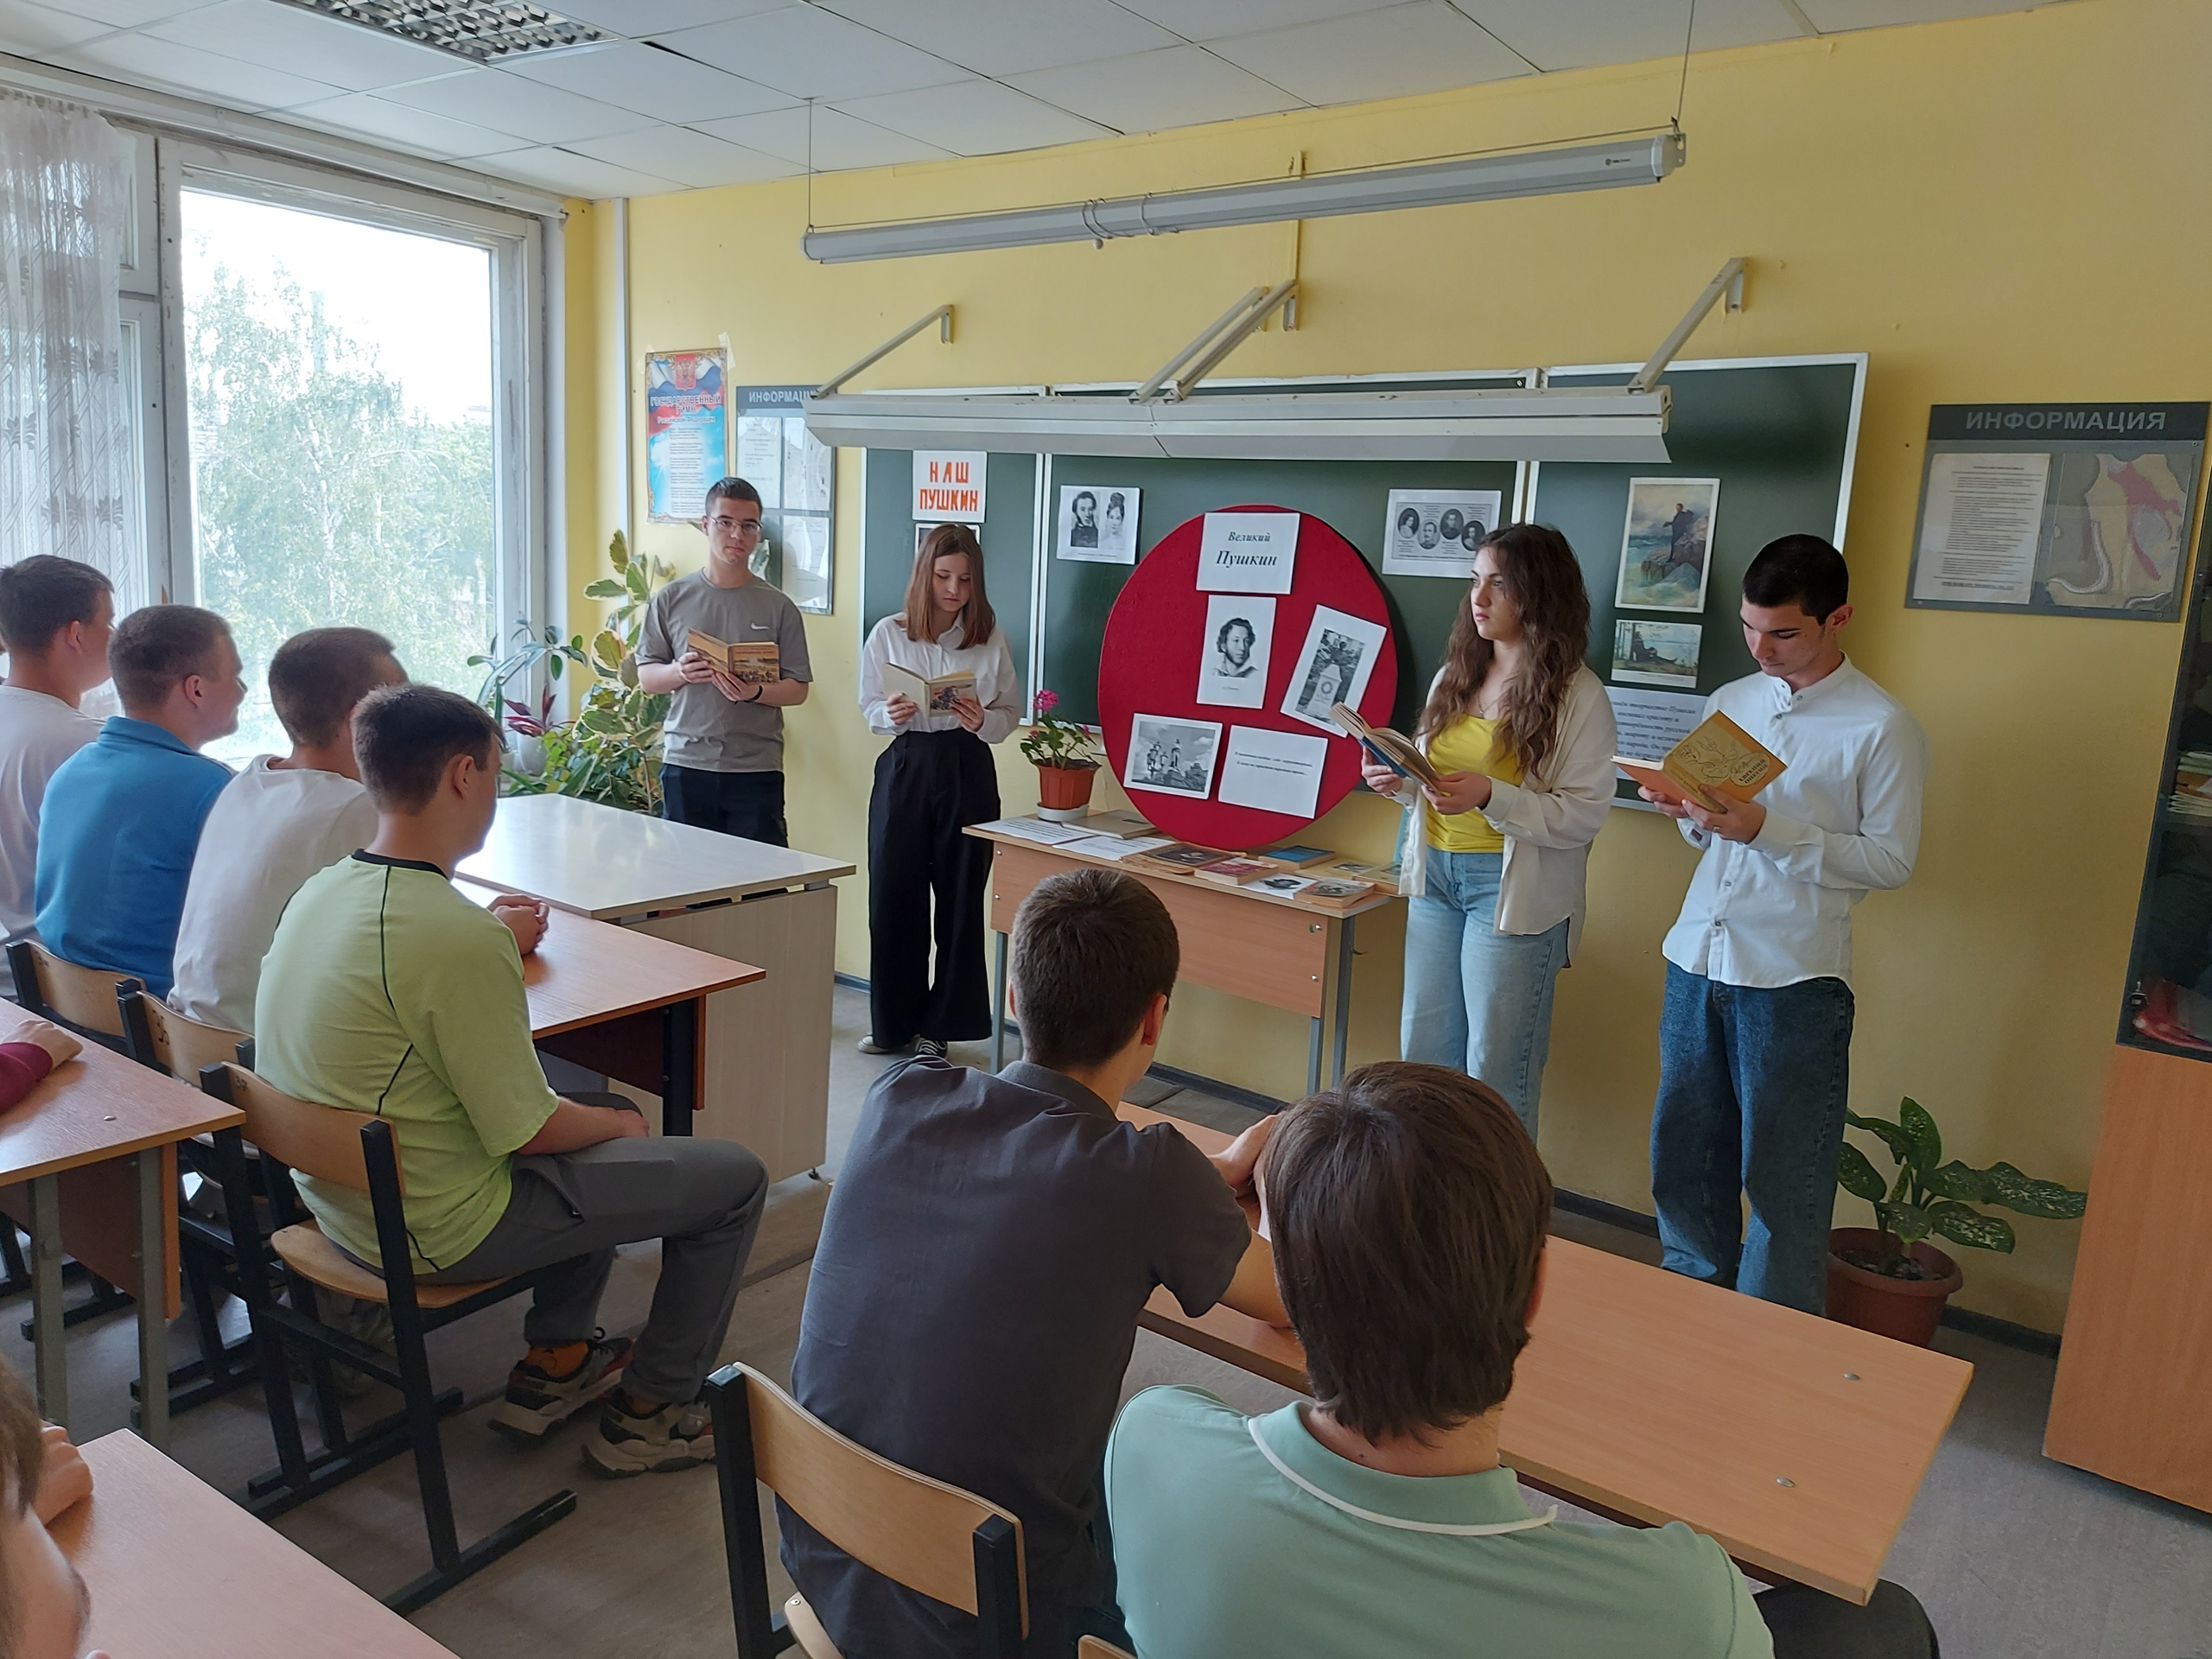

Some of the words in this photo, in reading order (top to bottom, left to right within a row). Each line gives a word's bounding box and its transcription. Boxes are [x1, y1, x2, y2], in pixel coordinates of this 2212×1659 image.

[650, 393, 721, 406] ГОСУДАРСТВЕННЫЙ
[748, 391, 810, 403] ИНФОРМАЦ
[676, 405, 696, 415] ГИМН
[1966, 411, 2166, 433] ИНФОРМАЦИЯ
[930, 461, 969, 484] НАШ
[919, 488, 979, 512] ПУШКИН
[1228, 531, 1271, 543] Великий
[1216, 550, 1277, 569] Пушкин
